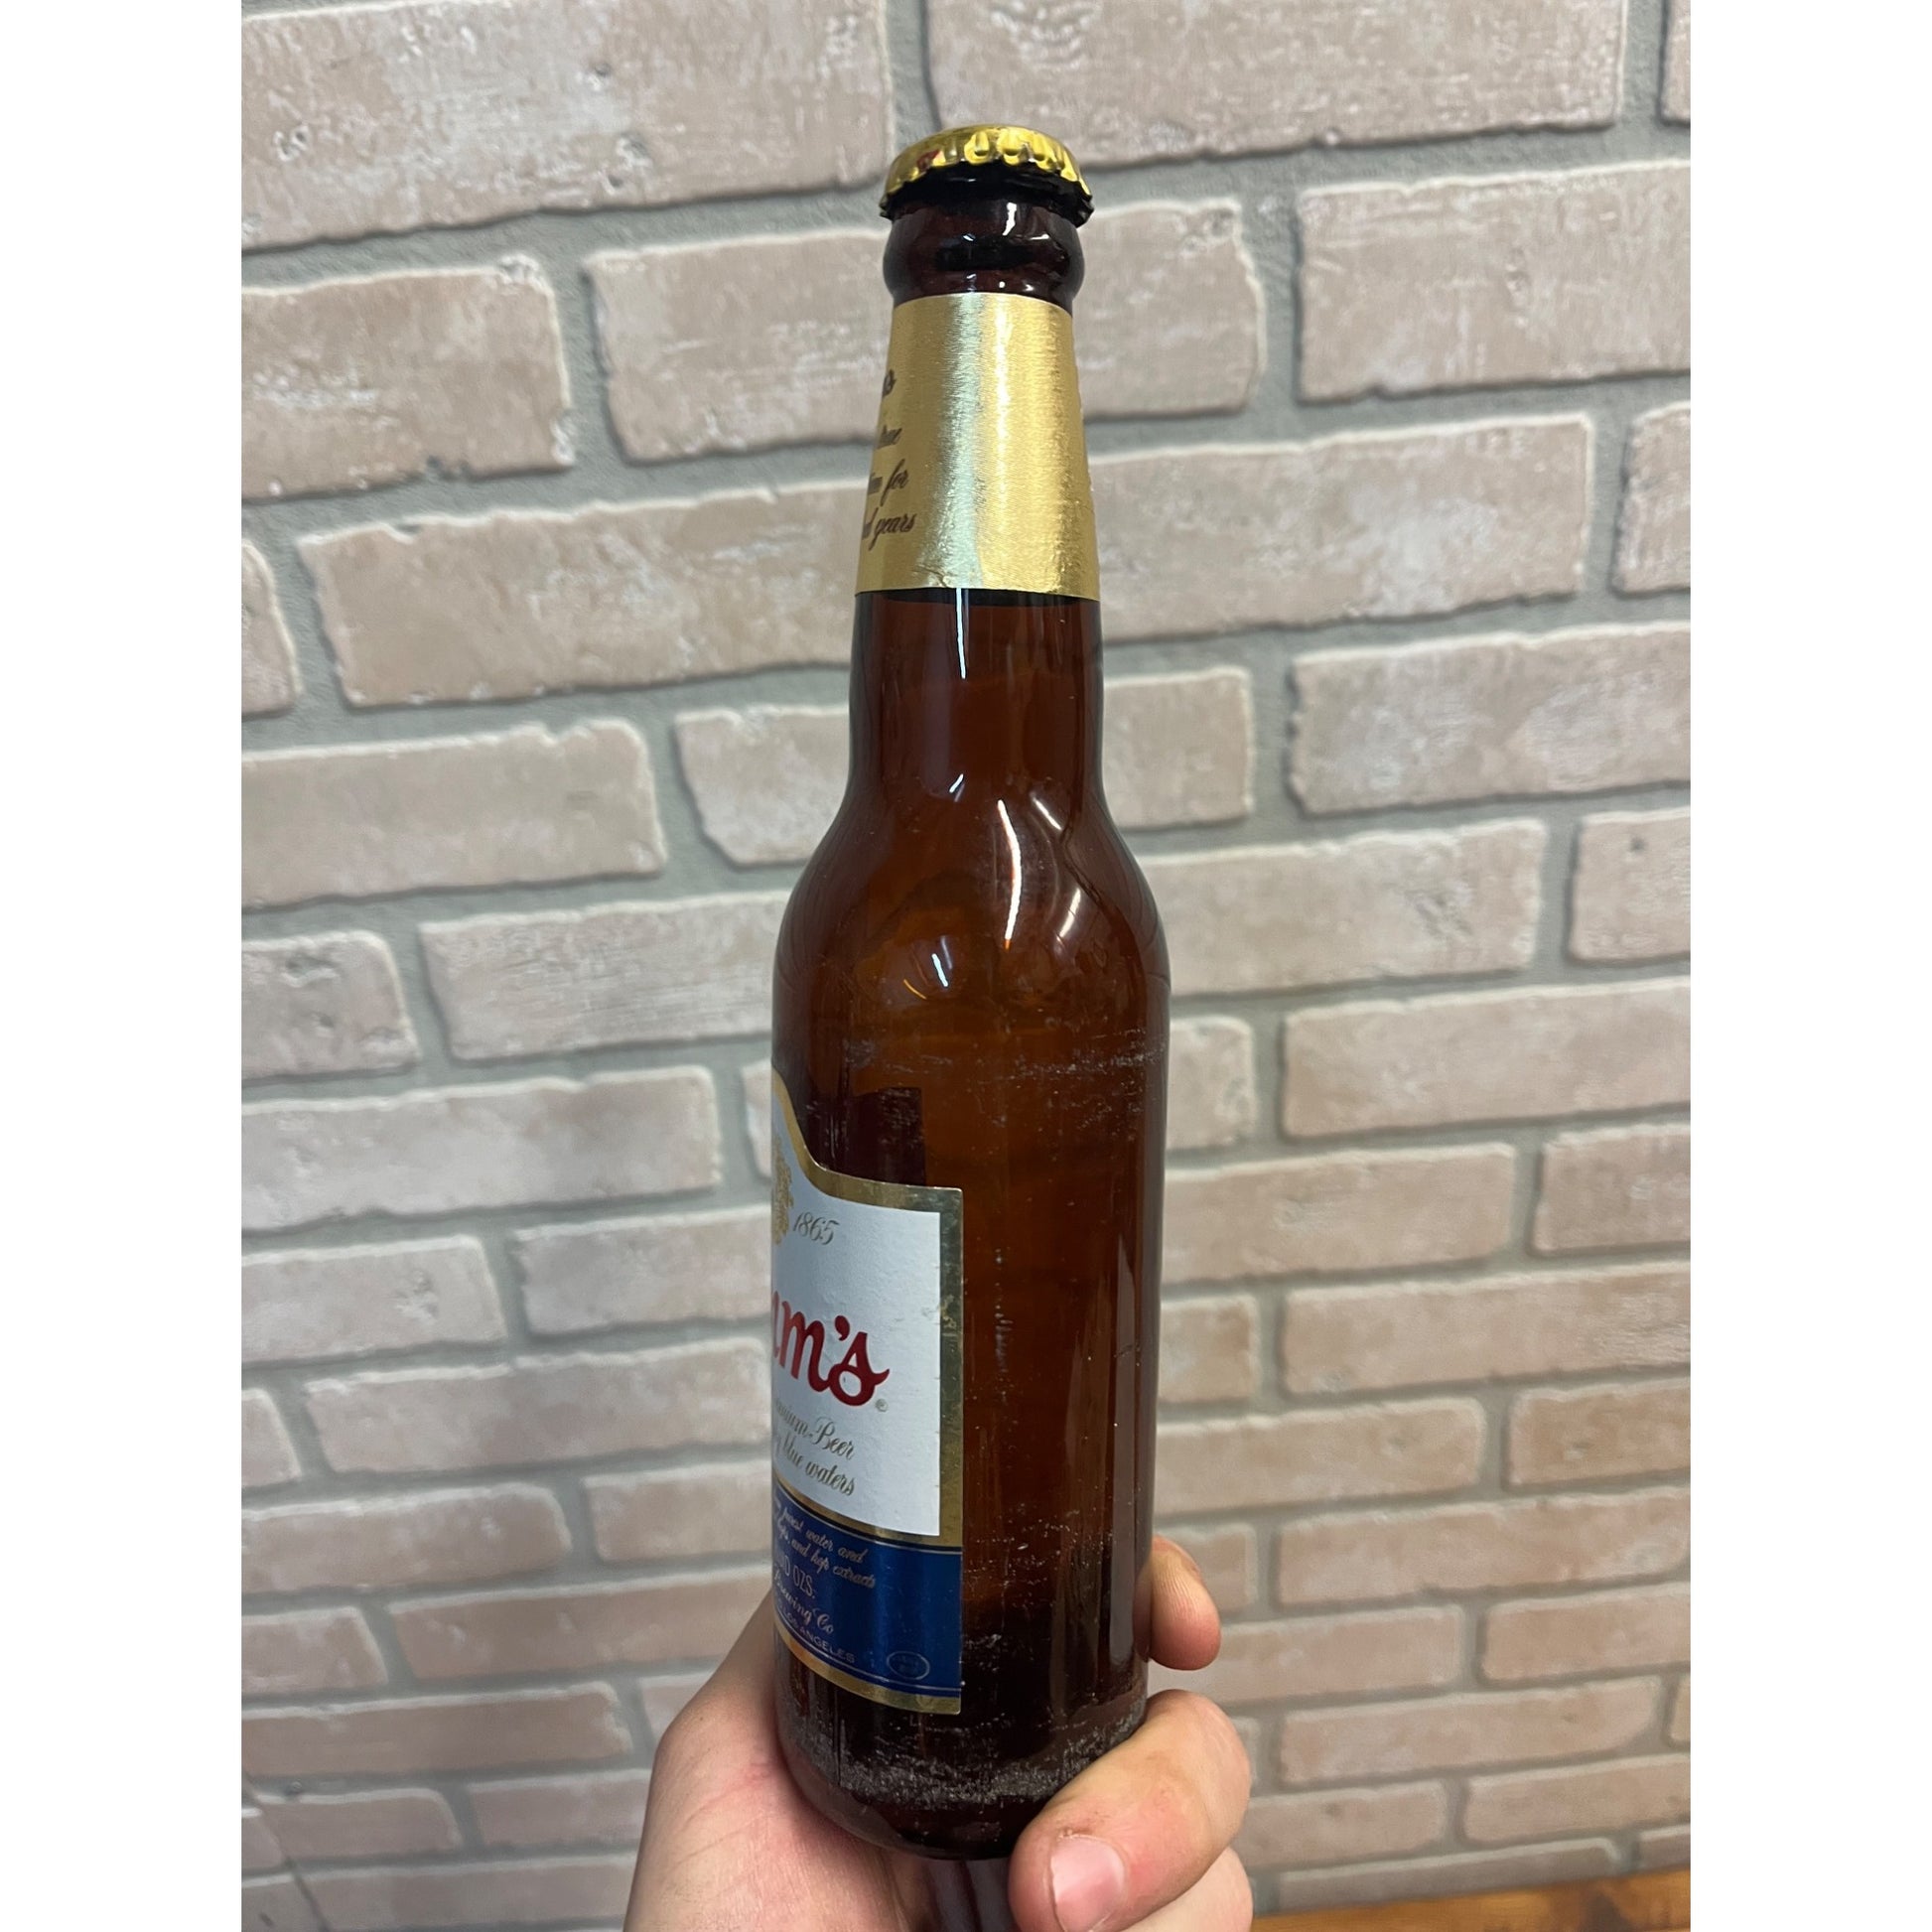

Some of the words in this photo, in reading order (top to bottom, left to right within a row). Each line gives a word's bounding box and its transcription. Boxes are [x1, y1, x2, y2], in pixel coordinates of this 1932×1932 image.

[880, 459, 909, 507] for
[869, 513, 917, 551] years
[793, 1211, 840, 1245] 1865
[772, 1291, 890, 1407] m's
[811, 1416, 856, 1460] Beer
[805, 1464, 856, 1496] waters
[791, 1538, 811, 1559] and
[810, 1549, 830, 1575] hop
[832, 1565, 876, 1588] extracts
[805, 1529, 834, 1553] water
[838, 1548, 869, 1564] and
[793, 1564, 816, 1599] OZS.
[813, 1606, 835, 1635] Co
[799, 1626, 855, 1663] ANGELES
